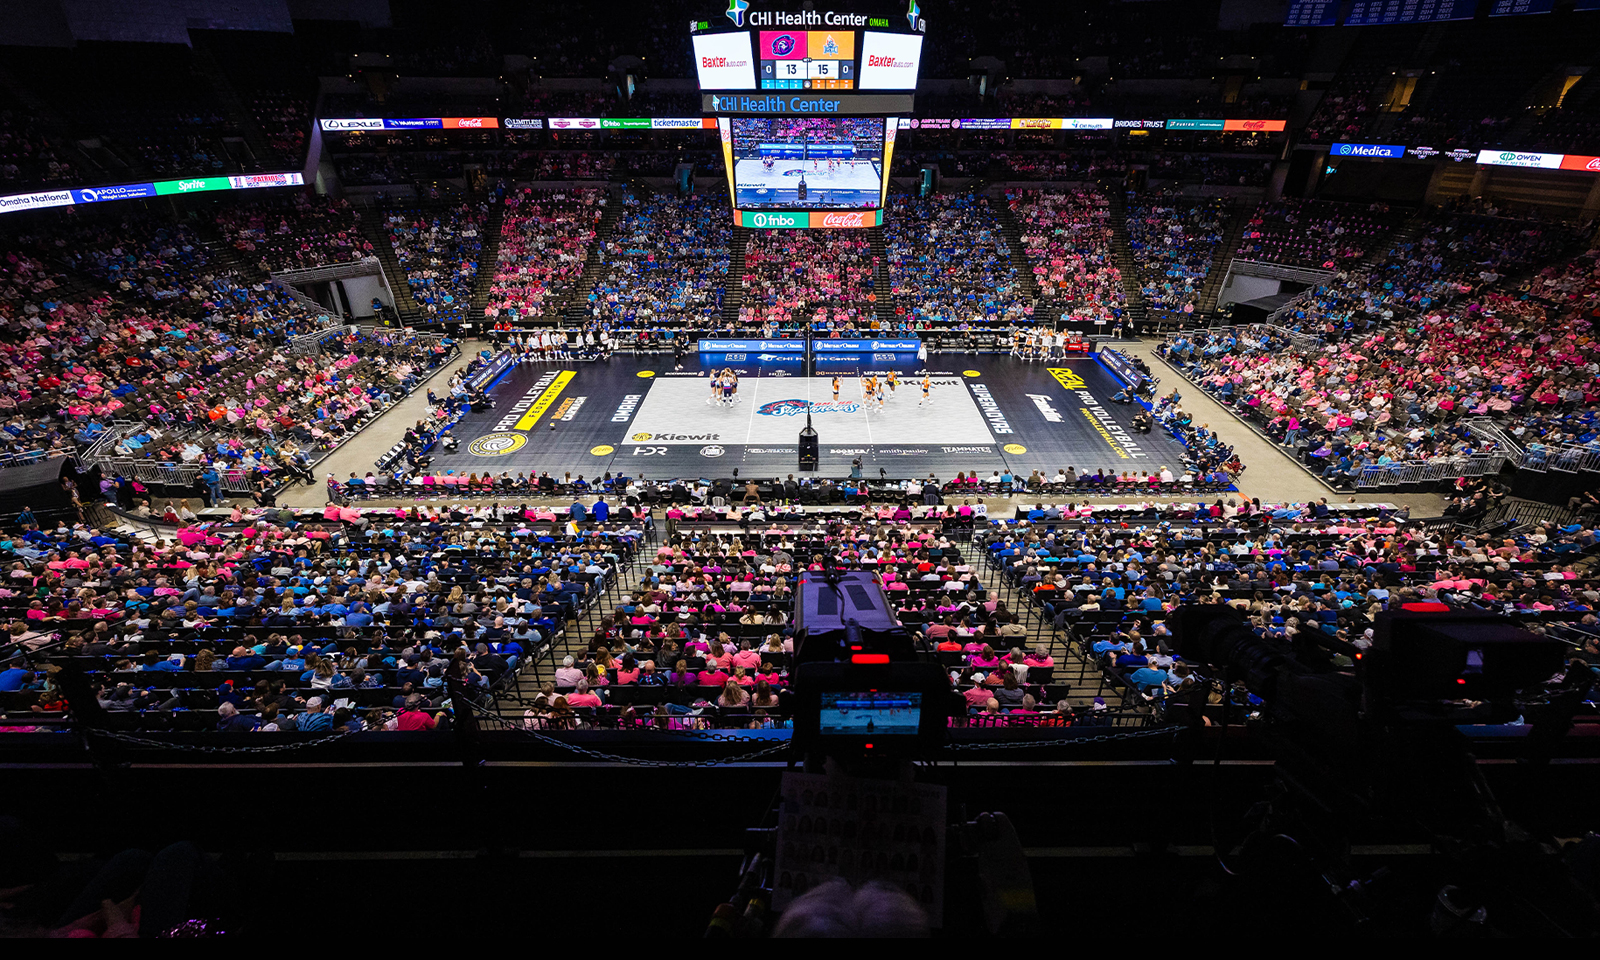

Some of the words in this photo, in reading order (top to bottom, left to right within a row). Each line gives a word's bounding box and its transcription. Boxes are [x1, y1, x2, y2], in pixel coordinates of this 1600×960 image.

[749, 12, 772, 26] CHI
[776, 11, 821, 25] Health
[824, 11, 868, 26] Center
[869, 18, 889, 28] OMAHA
[765, 65, 772, 74] 0
[786, 65, 797, 75] 13
[818, 65, 829, 75] 15
[842, 66, 849, 75] 0
[719, 96, 737, 112] CHI
[741, 96, 786, 112] Health
[789, 97, 840, 113] Center
[653, 119, 700, 127] ticketmaster
[1516, 154, 1542, 162] OWEN
[96, 187, 126, 196] APOLLO
[178, 180, 206, 192] Sprite
[31, 192, 70, 203] National
[768, 214, 795, 226] fnbo
[1046, 367, 1088, 391] REAL
[492, 414, 521, 432] PRO
[508, 369, 561, 414] VOLLEYBALL
[528, 381, 565, 418] FEDERATION
[610, 394, 642, 423] OMAHA
[1074, 390, 1098, 405] PRO
[1089, 405, 1147, 459] VOLLEYBALL
[653, 433, 721, 441] Kiewit
[632, 446, 668, 456] HDR
[941, 446, 992, 454] TEAMMATES
